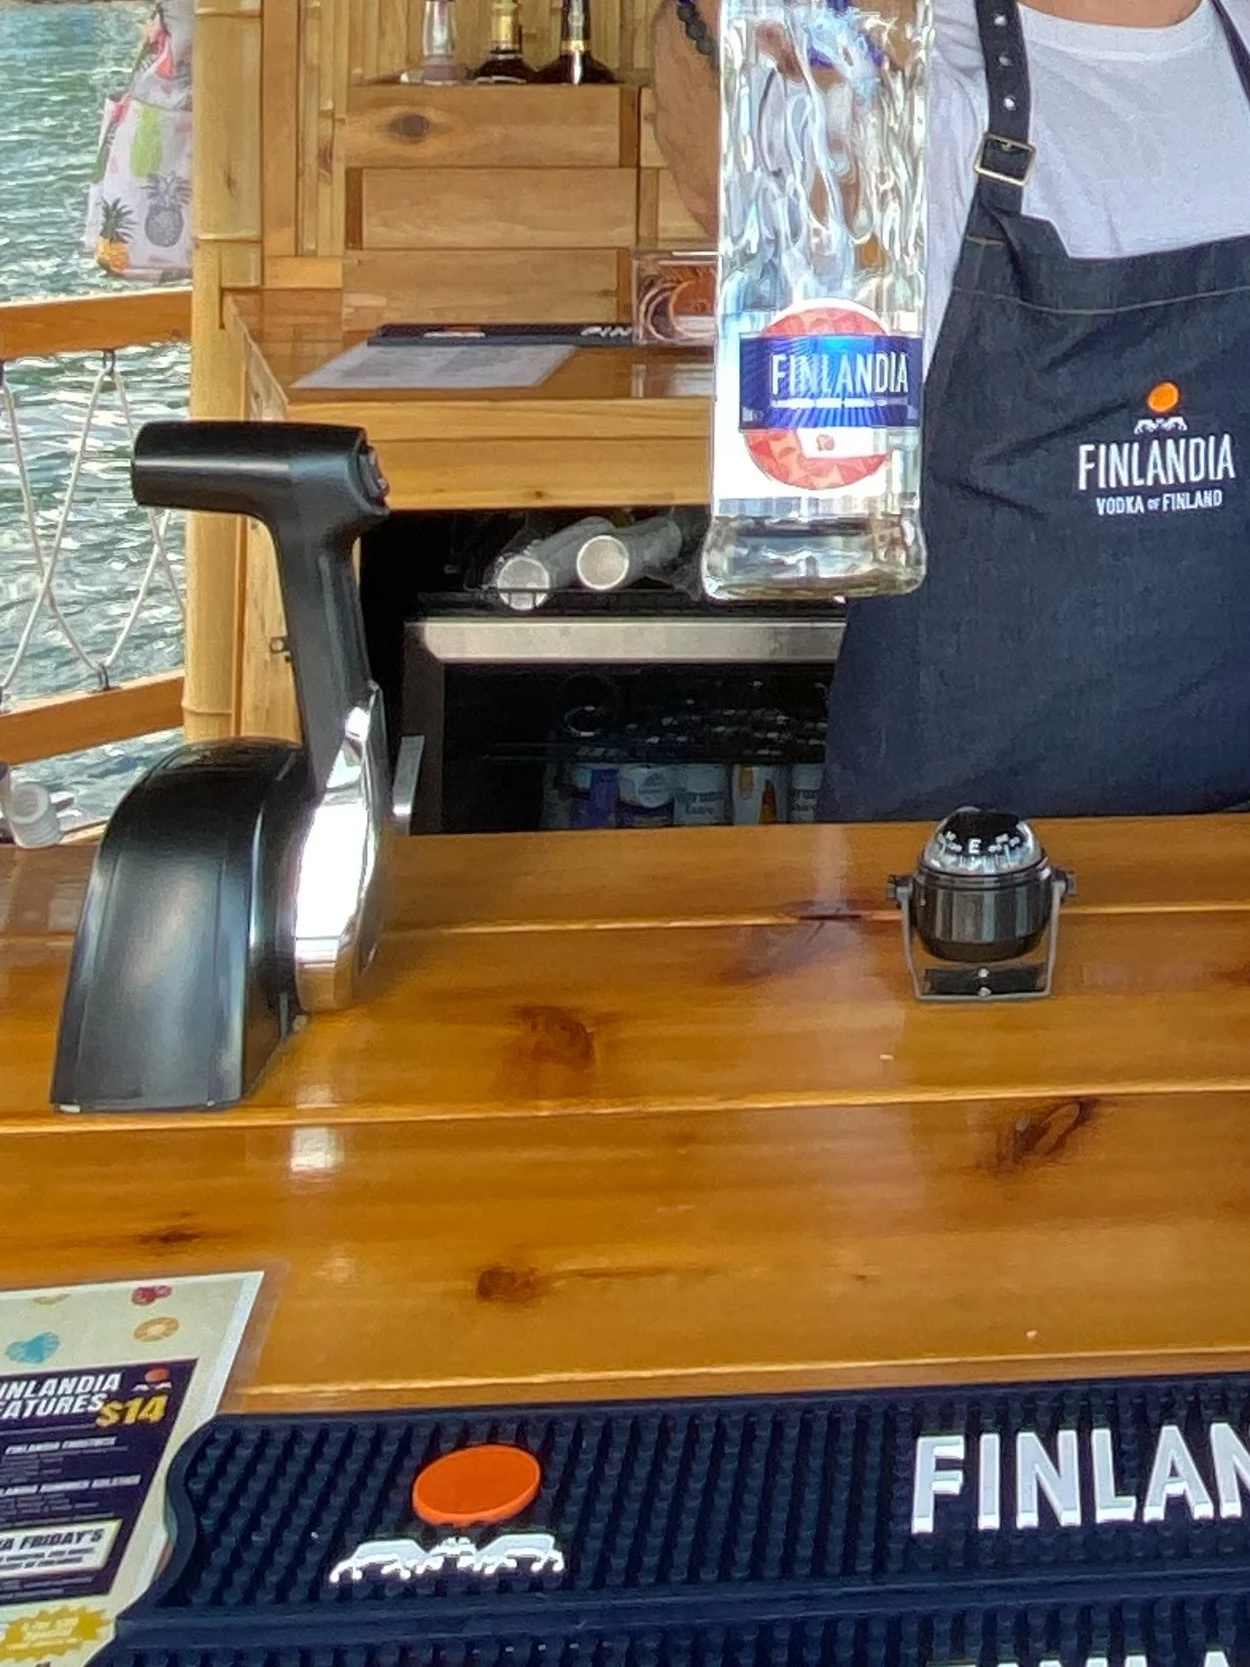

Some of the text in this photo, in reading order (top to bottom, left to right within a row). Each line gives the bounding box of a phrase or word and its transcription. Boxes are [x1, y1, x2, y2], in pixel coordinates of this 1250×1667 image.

[771, 352, 909, 396] FINLANDIA
[1078, 434, 1236, 490] FINLANDIA
[1096, 496, 1145, 516] VODKA
[1162, 489, 1222, 512] FINLAND
[0, 1372, 123, 1400] INLANDIA
[96, 1394, 168, 1427] $14
